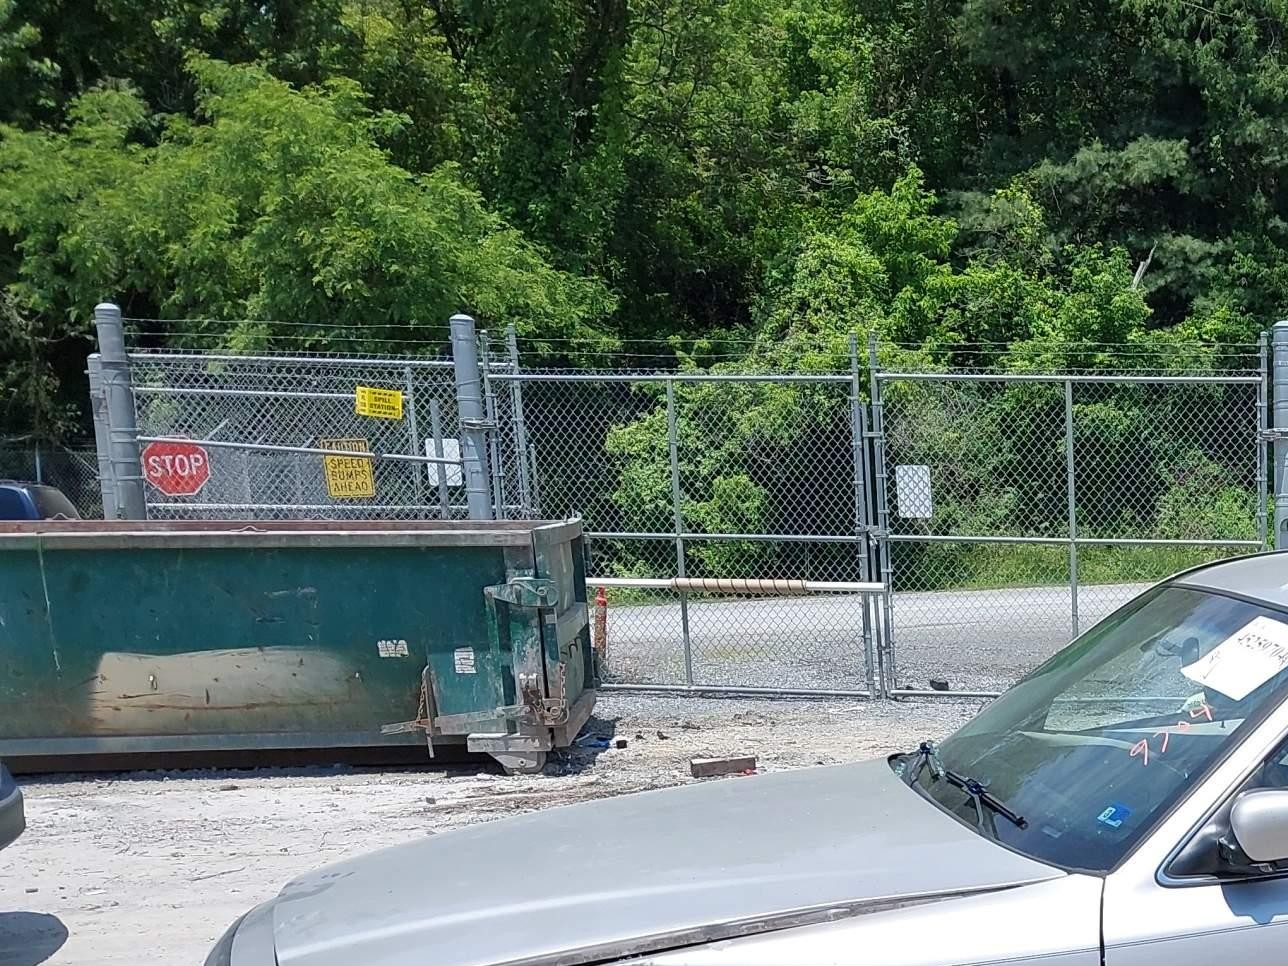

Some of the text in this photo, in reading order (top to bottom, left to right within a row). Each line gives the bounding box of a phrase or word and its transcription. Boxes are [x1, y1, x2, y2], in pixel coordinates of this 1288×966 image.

[148, 453, 203, 477] STOP
[330, 458, 364, 469] SPEED
[331, 470, 368, 481] BUMPS
[334, 481, 369, 491] AHEAD
